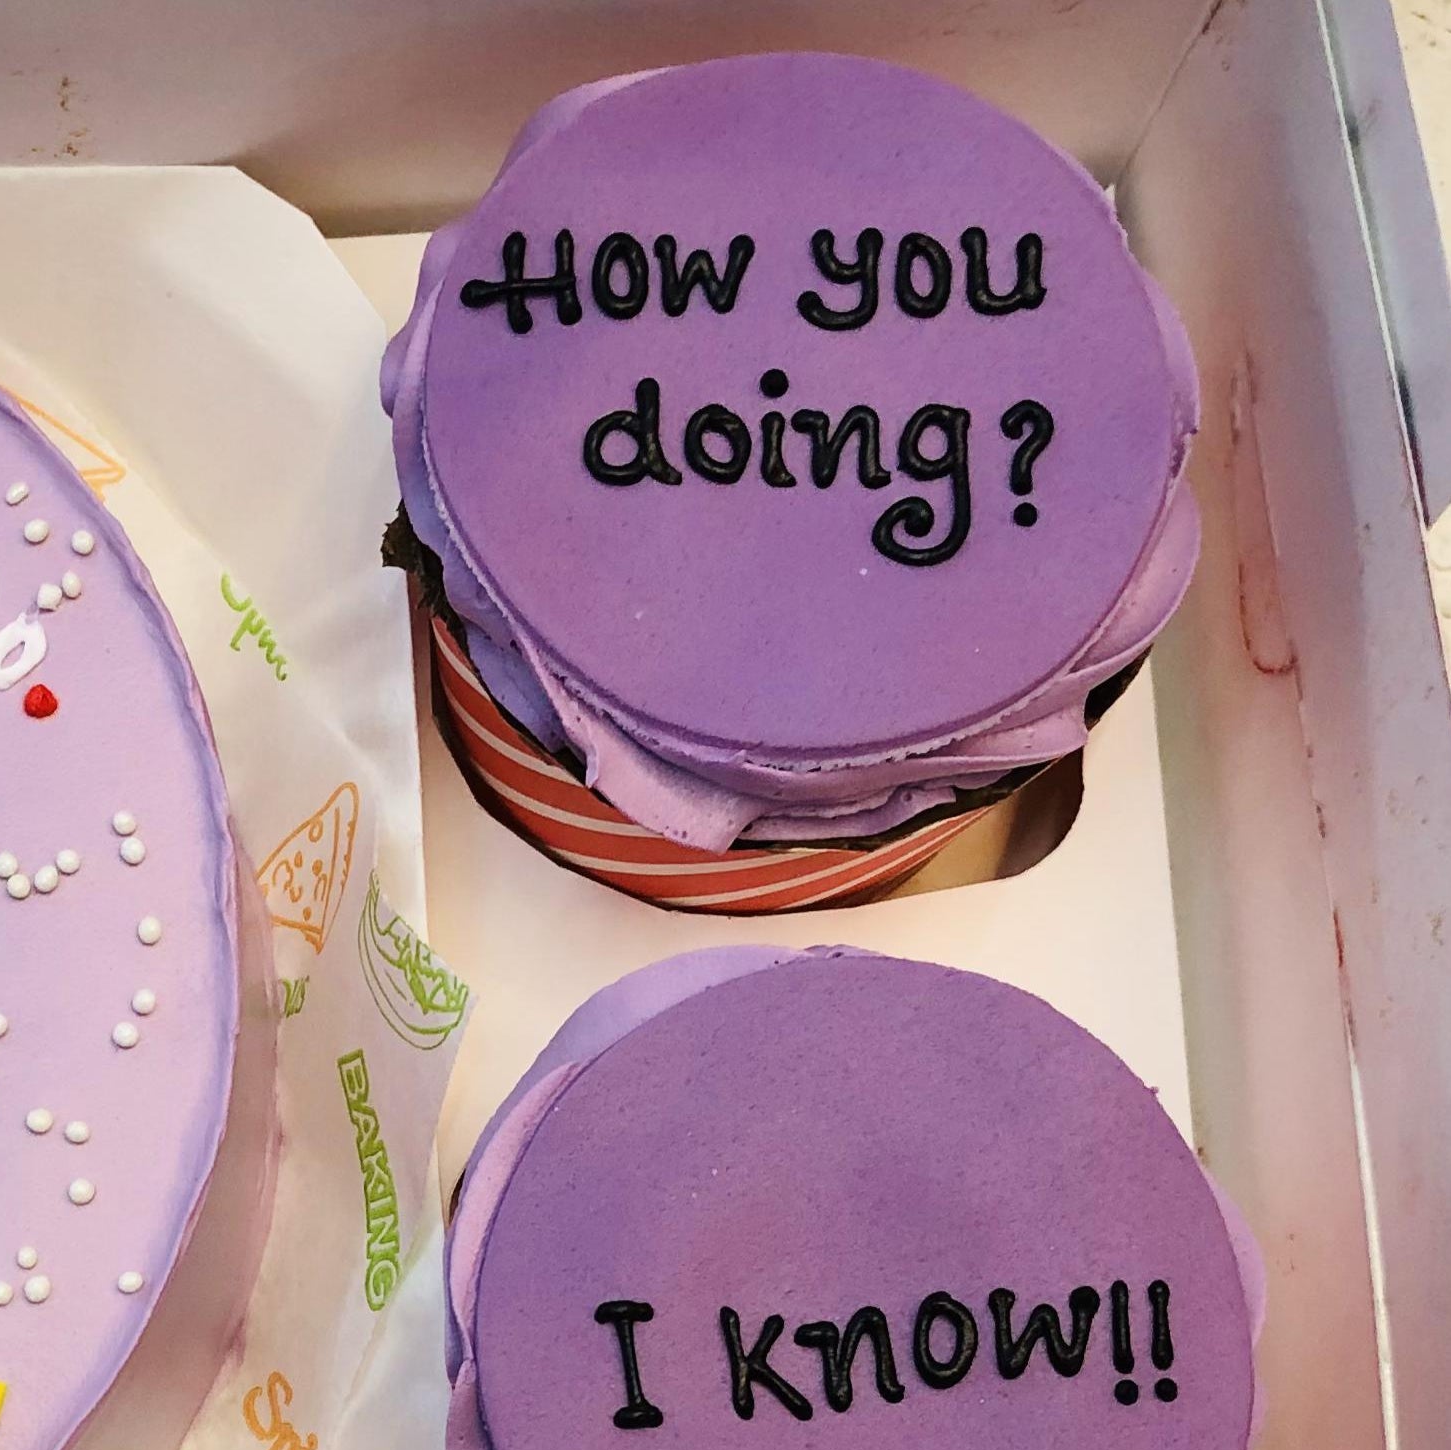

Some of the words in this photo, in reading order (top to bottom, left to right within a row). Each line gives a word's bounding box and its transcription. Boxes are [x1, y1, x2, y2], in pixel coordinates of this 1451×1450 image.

[797, 226, 1047, 331] you
[583, 368, 1053, 566] doing?
[337, 1048, 401, 1311] BAKING
[594, 1299, 664, 1429] I
